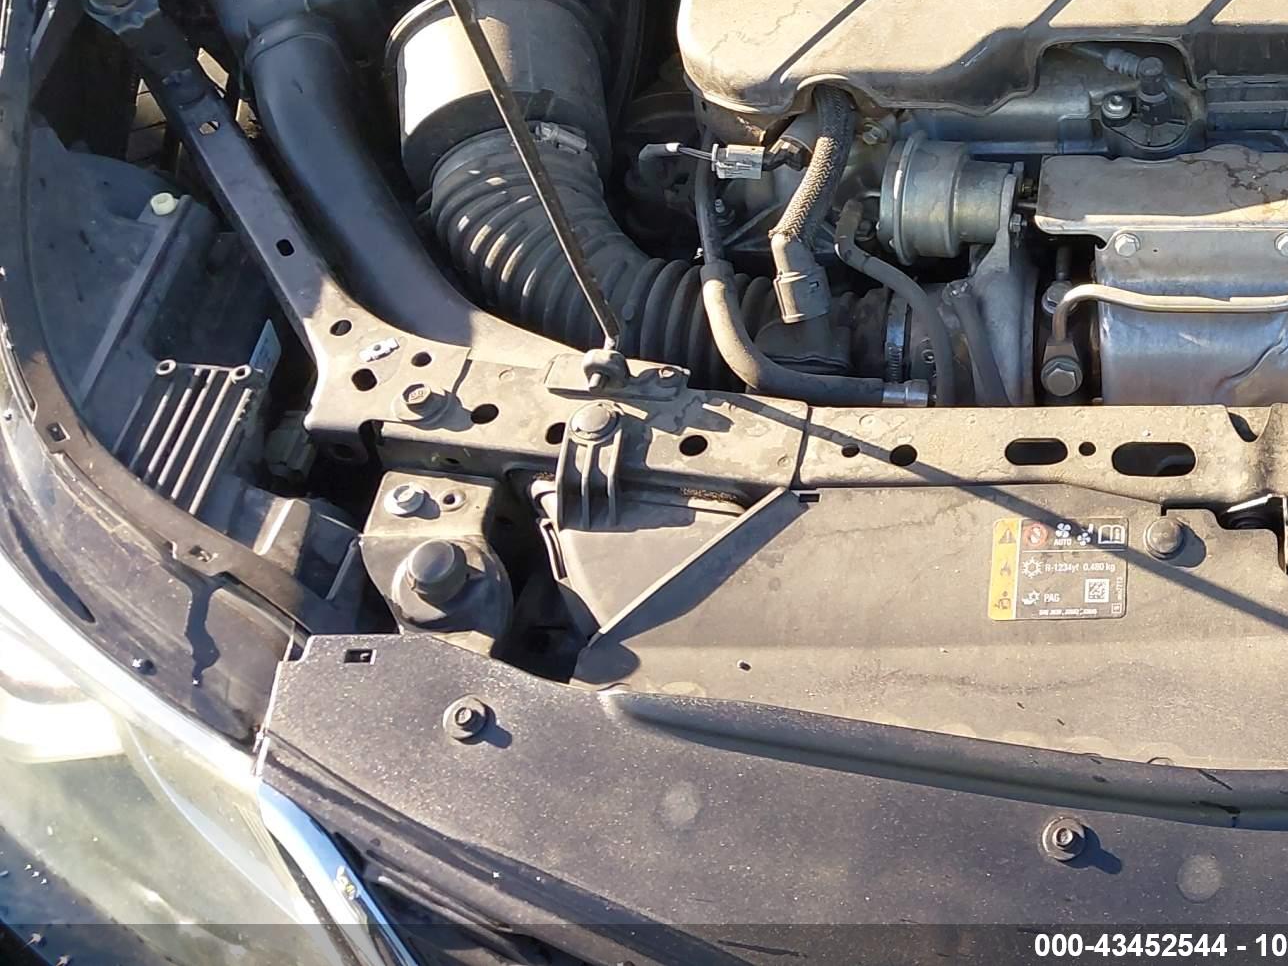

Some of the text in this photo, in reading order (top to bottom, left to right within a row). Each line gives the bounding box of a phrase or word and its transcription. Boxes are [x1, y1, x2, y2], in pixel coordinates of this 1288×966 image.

[1053, 538, 1072, 546] AUTO
[1105, 562, 1116, 573] kg
[1043, 593, 1061, 603] PAG
